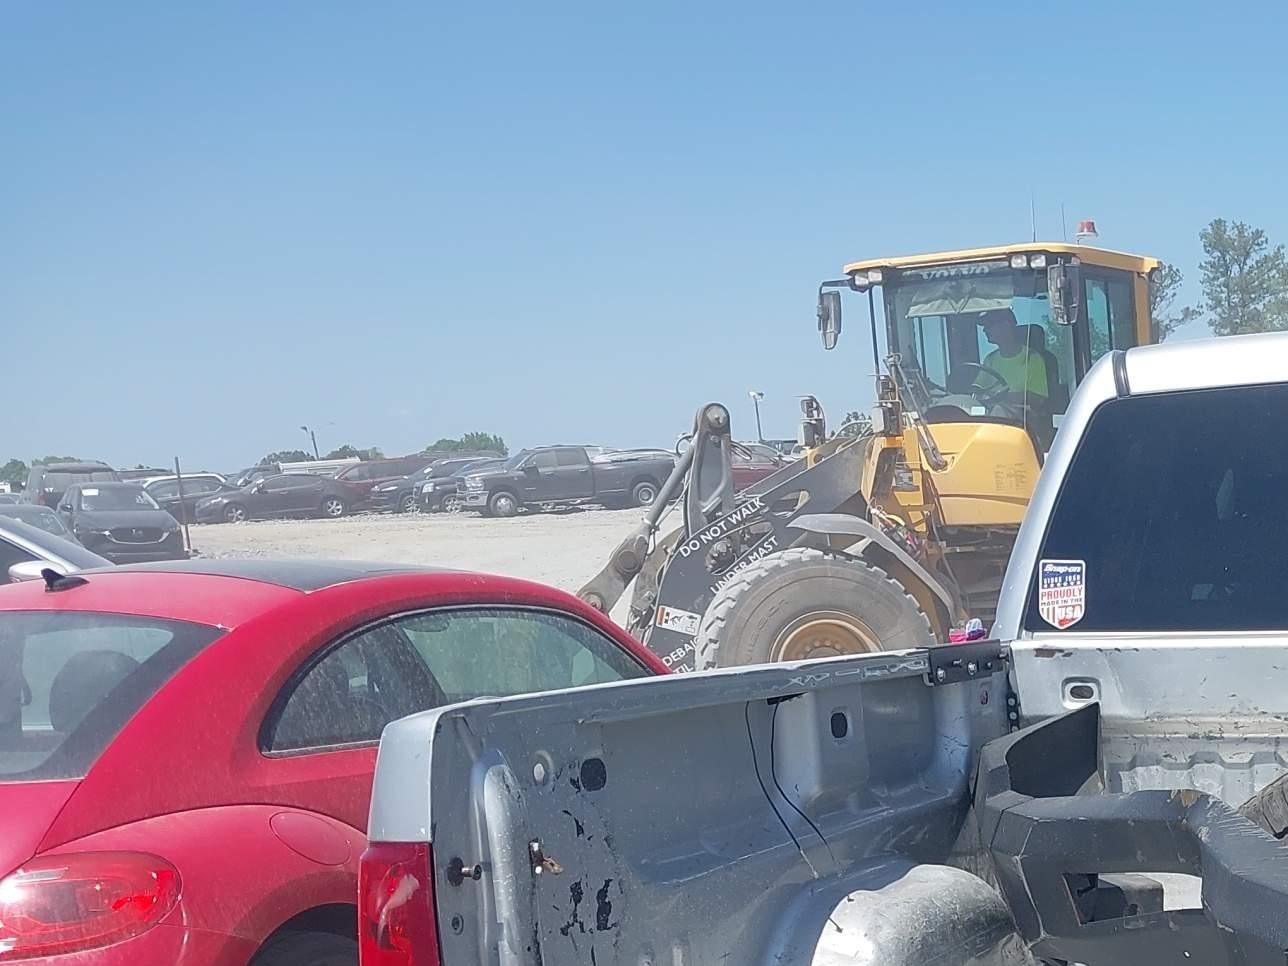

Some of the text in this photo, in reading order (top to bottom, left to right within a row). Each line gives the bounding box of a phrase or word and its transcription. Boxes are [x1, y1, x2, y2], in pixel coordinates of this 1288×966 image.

[680, 497, 765, 557] DO NOT WALK
[710, 535, 779, 594] UNDER MAST
[1041, 587, 1083, 600] PROUDLY
[1057, 605, 1082, 620] USA
